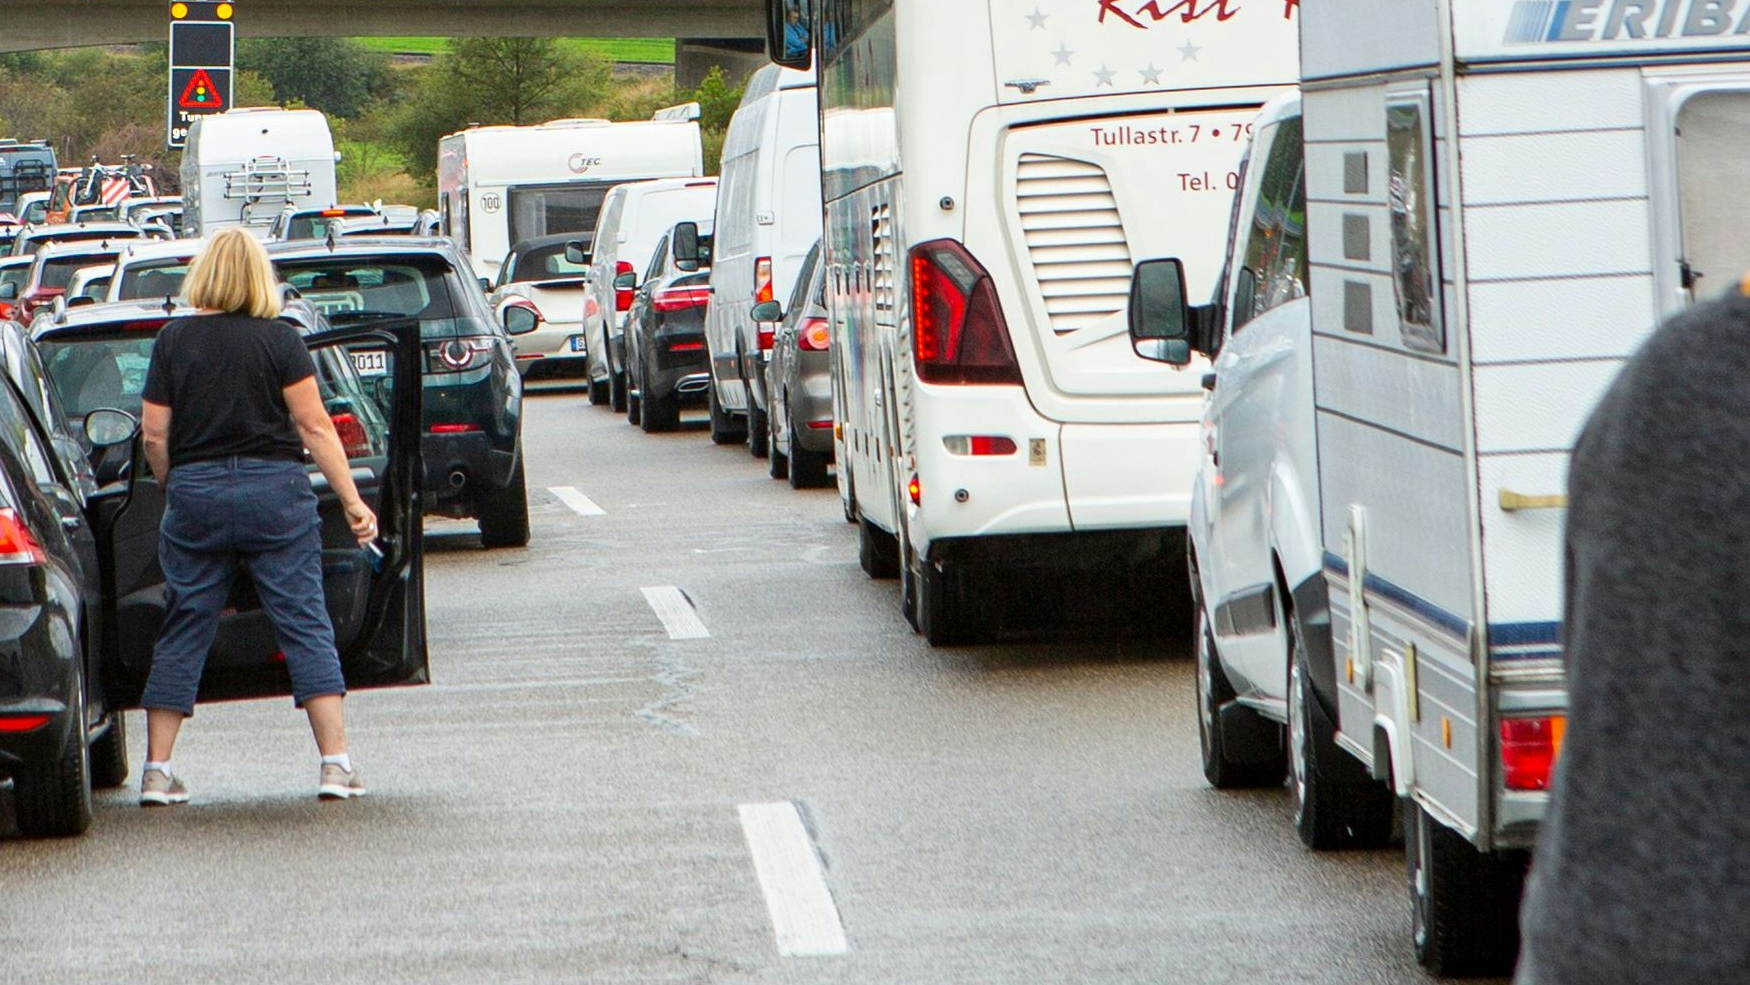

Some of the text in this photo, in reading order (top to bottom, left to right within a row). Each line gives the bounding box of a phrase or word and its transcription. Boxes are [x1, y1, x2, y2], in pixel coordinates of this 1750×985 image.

[1090, 126, 1183, 146] Tullastr.
[1189, 125, 1201, 143] 7
[1177, 171, 1217, 191] Tel.
[482, 197, 500, 209] 100
